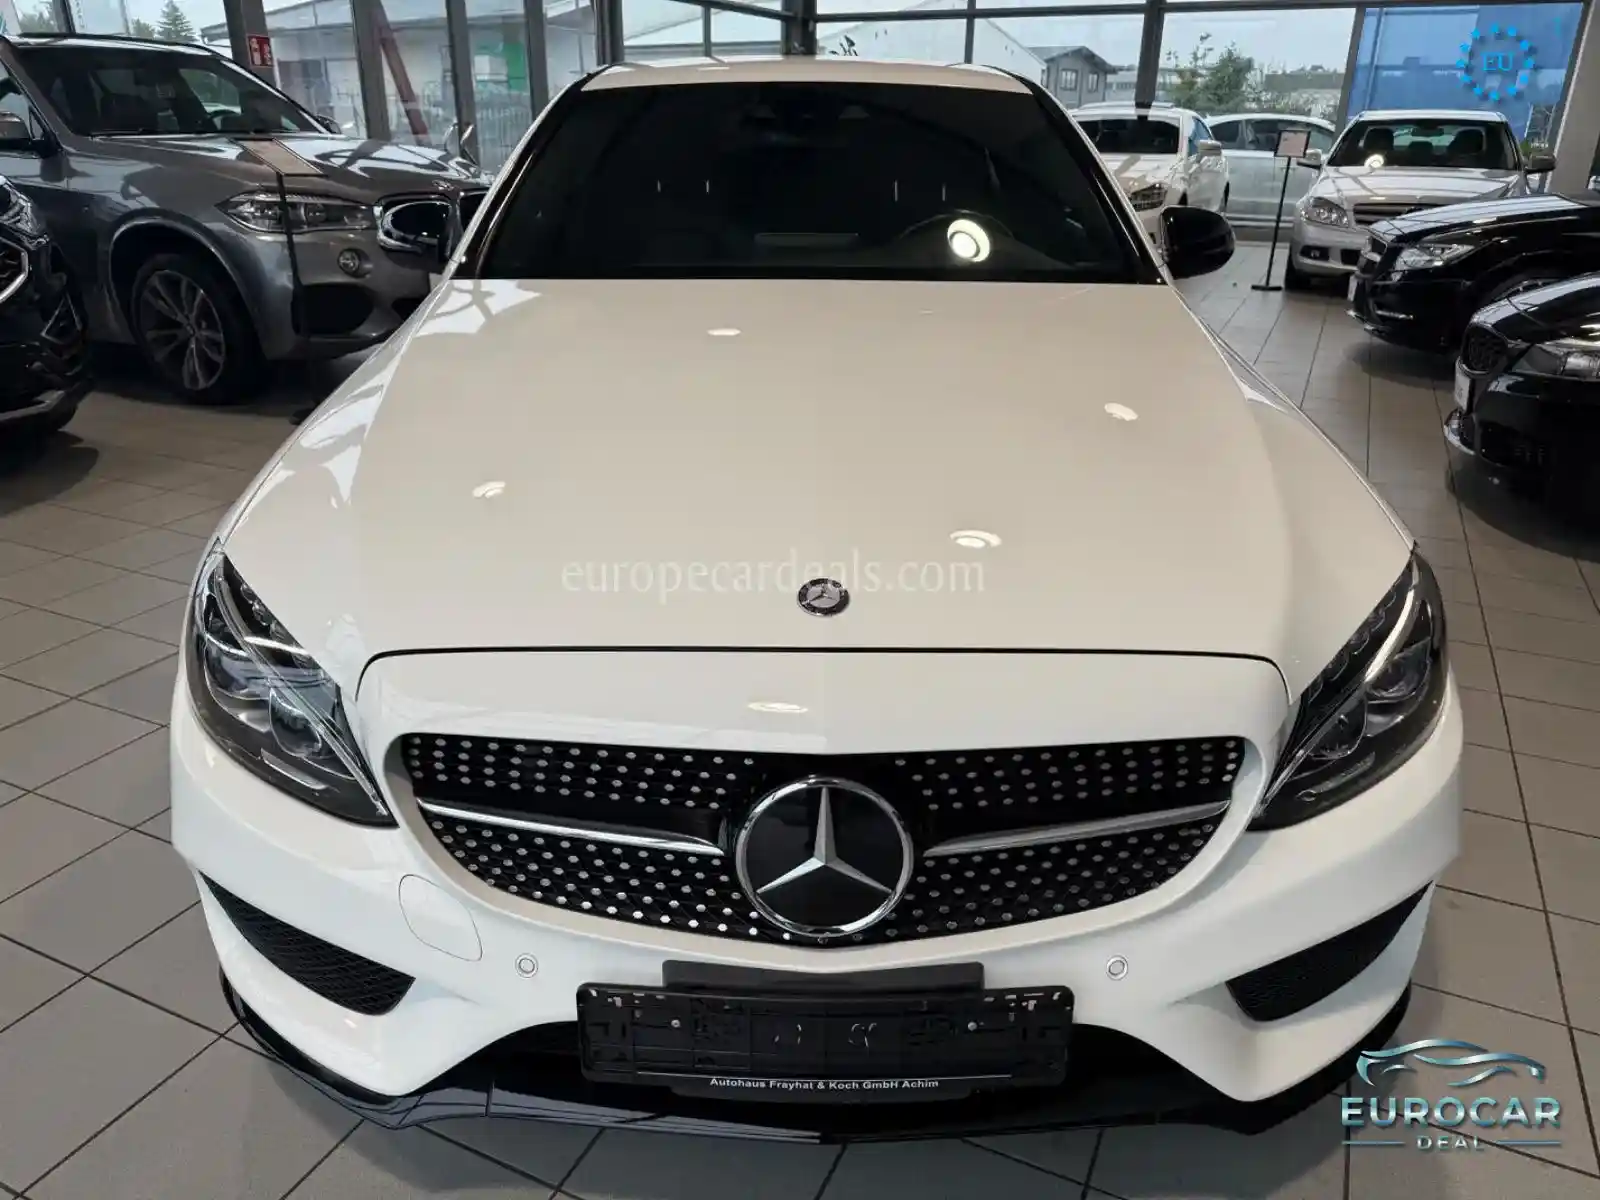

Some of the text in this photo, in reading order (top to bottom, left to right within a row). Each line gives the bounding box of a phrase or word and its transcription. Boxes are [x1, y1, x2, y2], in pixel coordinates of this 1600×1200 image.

[709, 1077, 939, 1091] Autohaus Frayhat & Koch GmbH Achim
